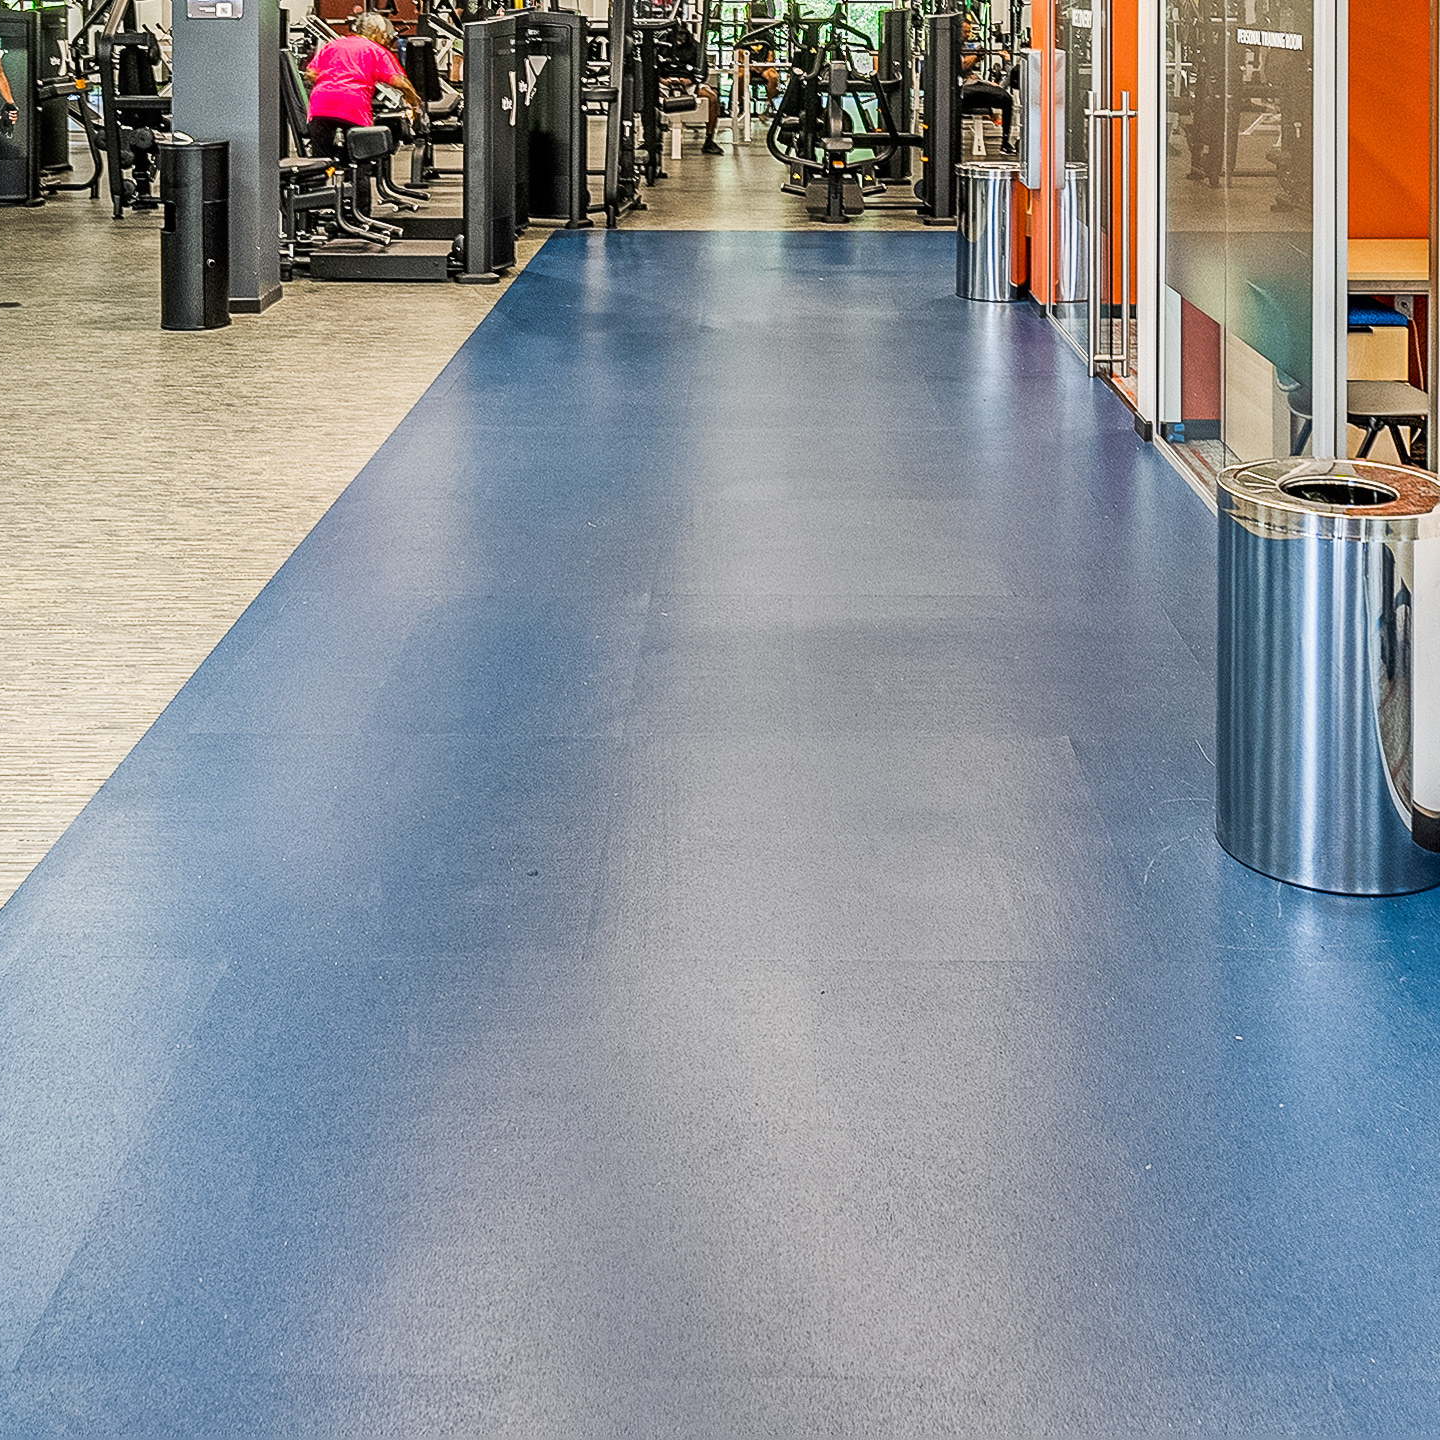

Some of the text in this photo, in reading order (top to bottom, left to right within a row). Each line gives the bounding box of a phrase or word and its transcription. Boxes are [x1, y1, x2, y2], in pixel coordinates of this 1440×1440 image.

[1237, 28, 1303, 51] PERSONAL TRAINING ROOM
